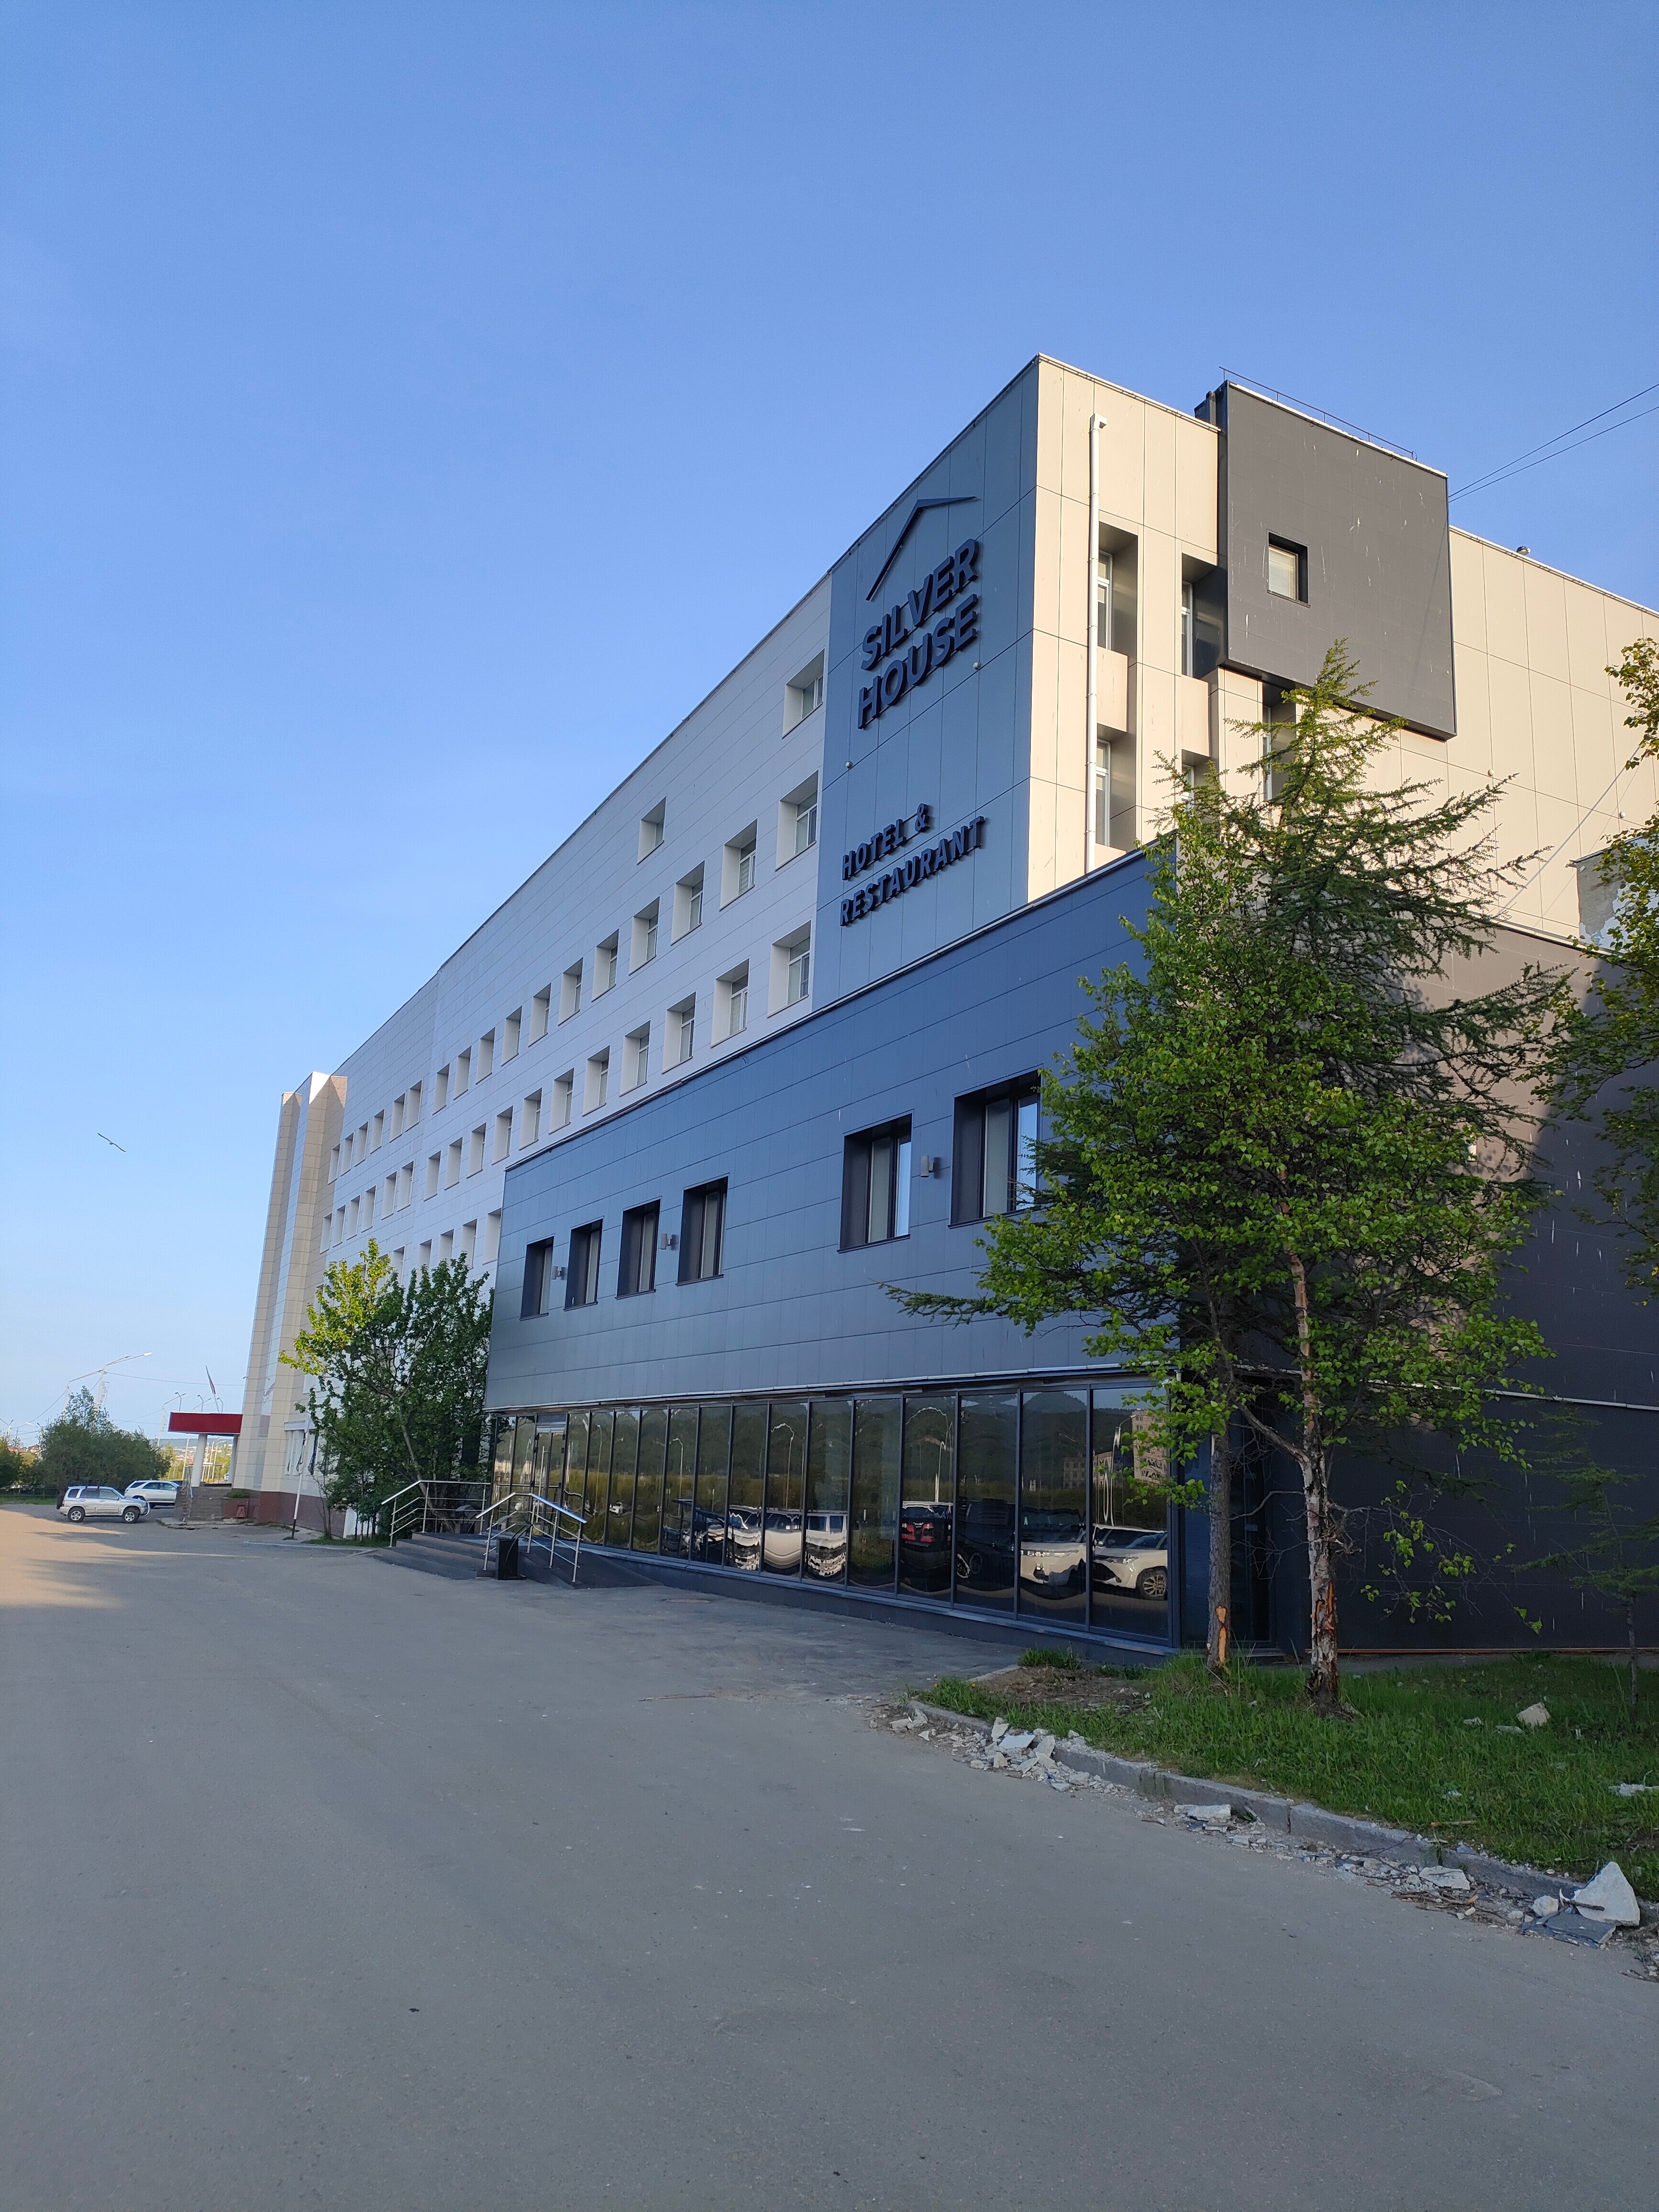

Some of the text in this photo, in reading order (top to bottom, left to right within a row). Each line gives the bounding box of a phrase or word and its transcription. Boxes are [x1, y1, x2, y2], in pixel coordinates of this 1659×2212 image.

[858, 594, 977, 730] HOUSE
[861, 538, 978, 670] SILVER
[840, 816, 985, 926] RESTAURANT
[842, 803, 929, 880] HOTEL &
